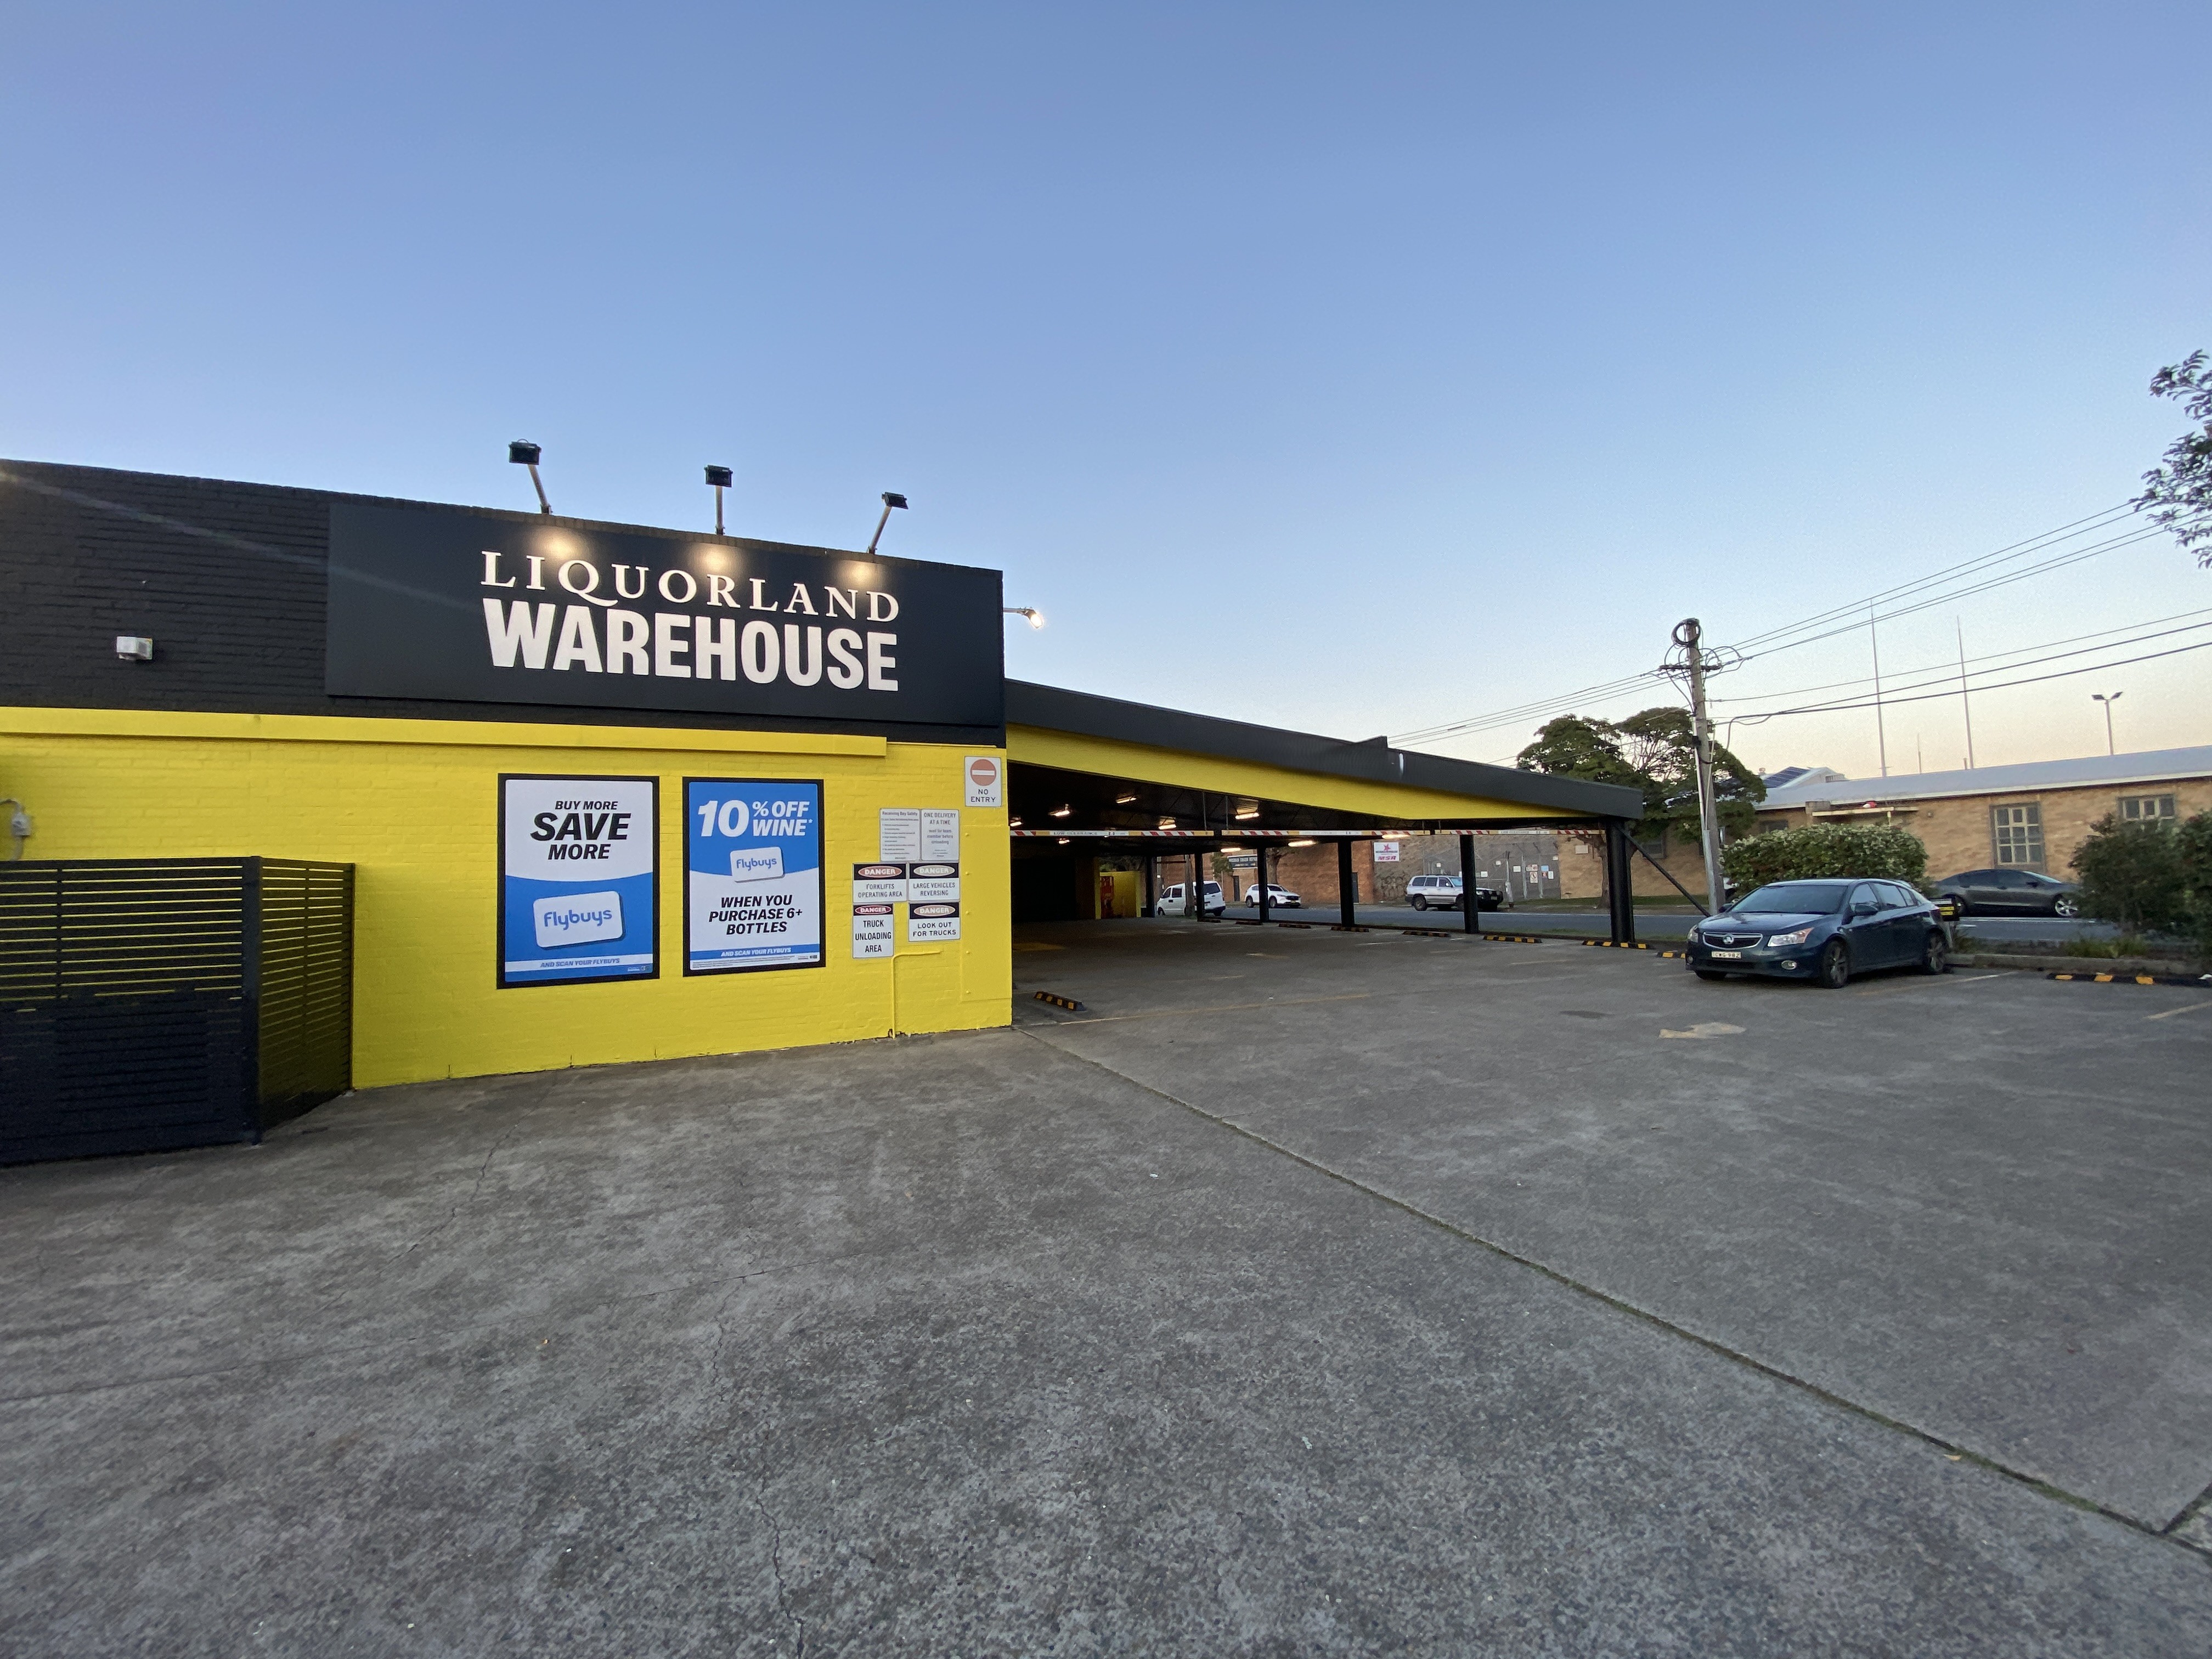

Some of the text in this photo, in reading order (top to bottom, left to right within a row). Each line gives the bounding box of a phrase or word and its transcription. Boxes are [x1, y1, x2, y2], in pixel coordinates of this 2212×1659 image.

[481, 550, 900, 622] LIQUORLAND
[482, 597, 899, 692] WAREHOUSE
[555, 800, 618, 810] BUY MORE
[530, 812, 631, 842] SAVE
[548, 844, 611, 860] MORE
[736, 857, 777, 871] flybuys
[721, 894, 793, 908] WHEN YOU
[544, 909, 612, 930] flybuys
[709, 908, 803, 922] PURCHASE 6+
[726, 921, 787, 935] BOTTLES
[863, 919, 884, 928] TRUCK
[855, 932, 891, 940] UNLOADING
[865, 945, 882, 953] AREA
